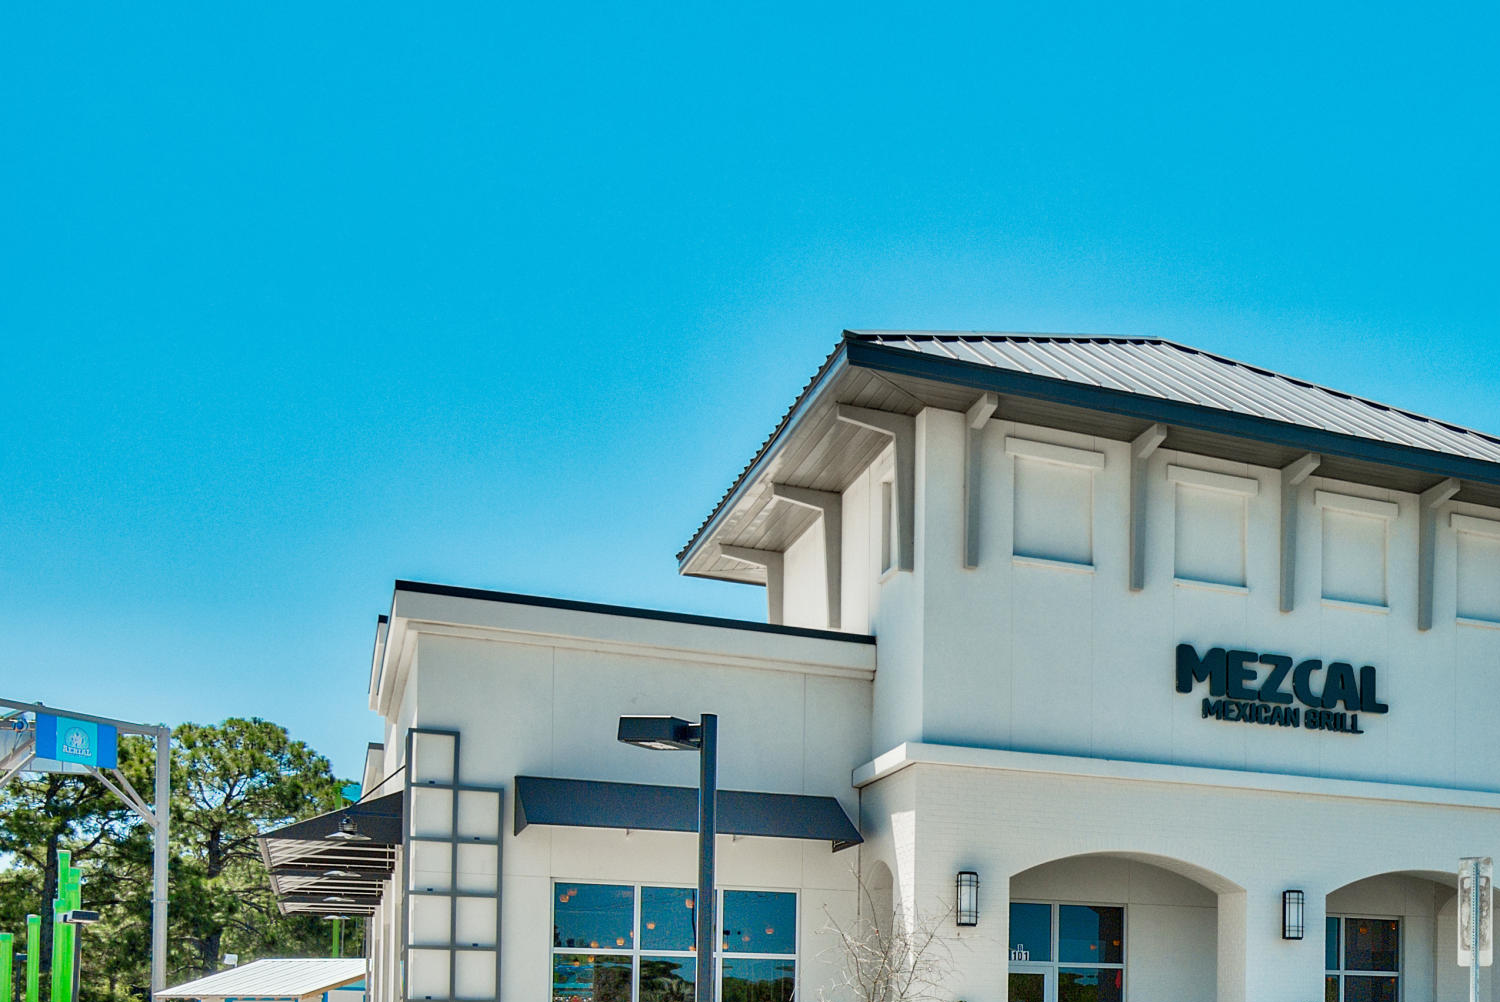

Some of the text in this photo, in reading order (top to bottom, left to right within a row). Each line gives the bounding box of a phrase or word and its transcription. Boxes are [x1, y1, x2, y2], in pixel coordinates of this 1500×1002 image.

[1175, 643, 1389, 713] MEZCAL
[1201, 698, 1364, 734] MEXICAN GRILL
[1012, 951, 1029, 960] 101
